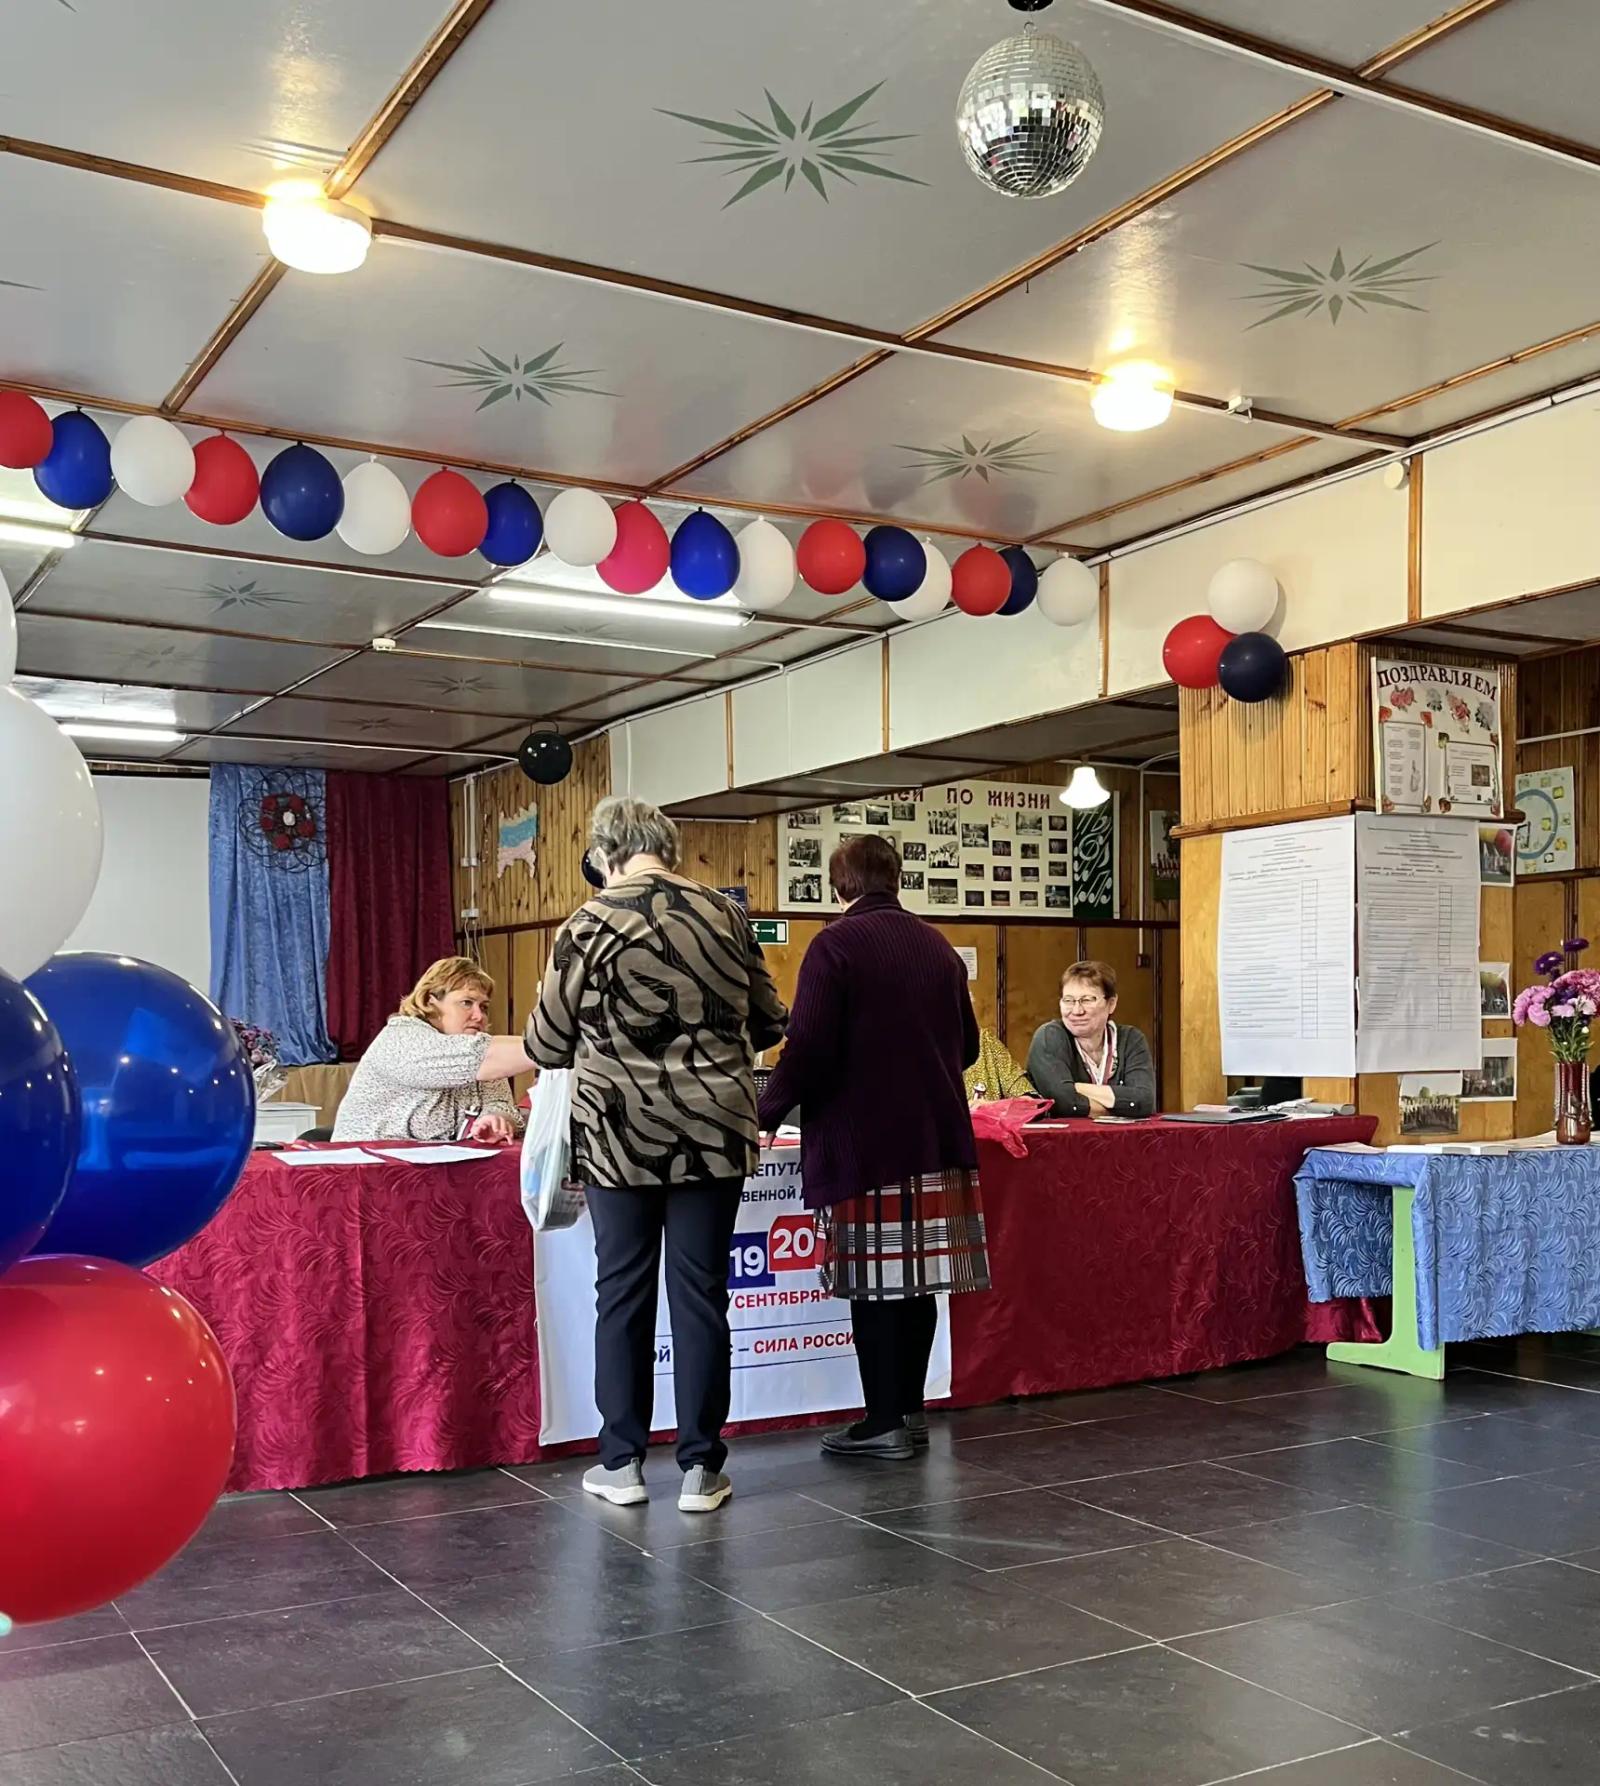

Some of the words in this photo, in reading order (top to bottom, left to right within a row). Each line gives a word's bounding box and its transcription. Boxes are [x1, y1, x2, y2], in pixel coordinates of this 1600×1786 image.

[1377, 665, 1497, 701] ПОЗДРАВЛЯЕМ
[947, 788, 973, 805] ПО
[988, 790, 1051, 809] ЖИЗНИ
[751, 1162, 804, 1179] ЕПУТА
[730, 1245, 766, 1278] 19
[772, 1227, 815, 1260] 20
[734, 1289, 821, 1309] СЕНТЯБРЯ
[753, 1338, 799, 1354] СИЛА
